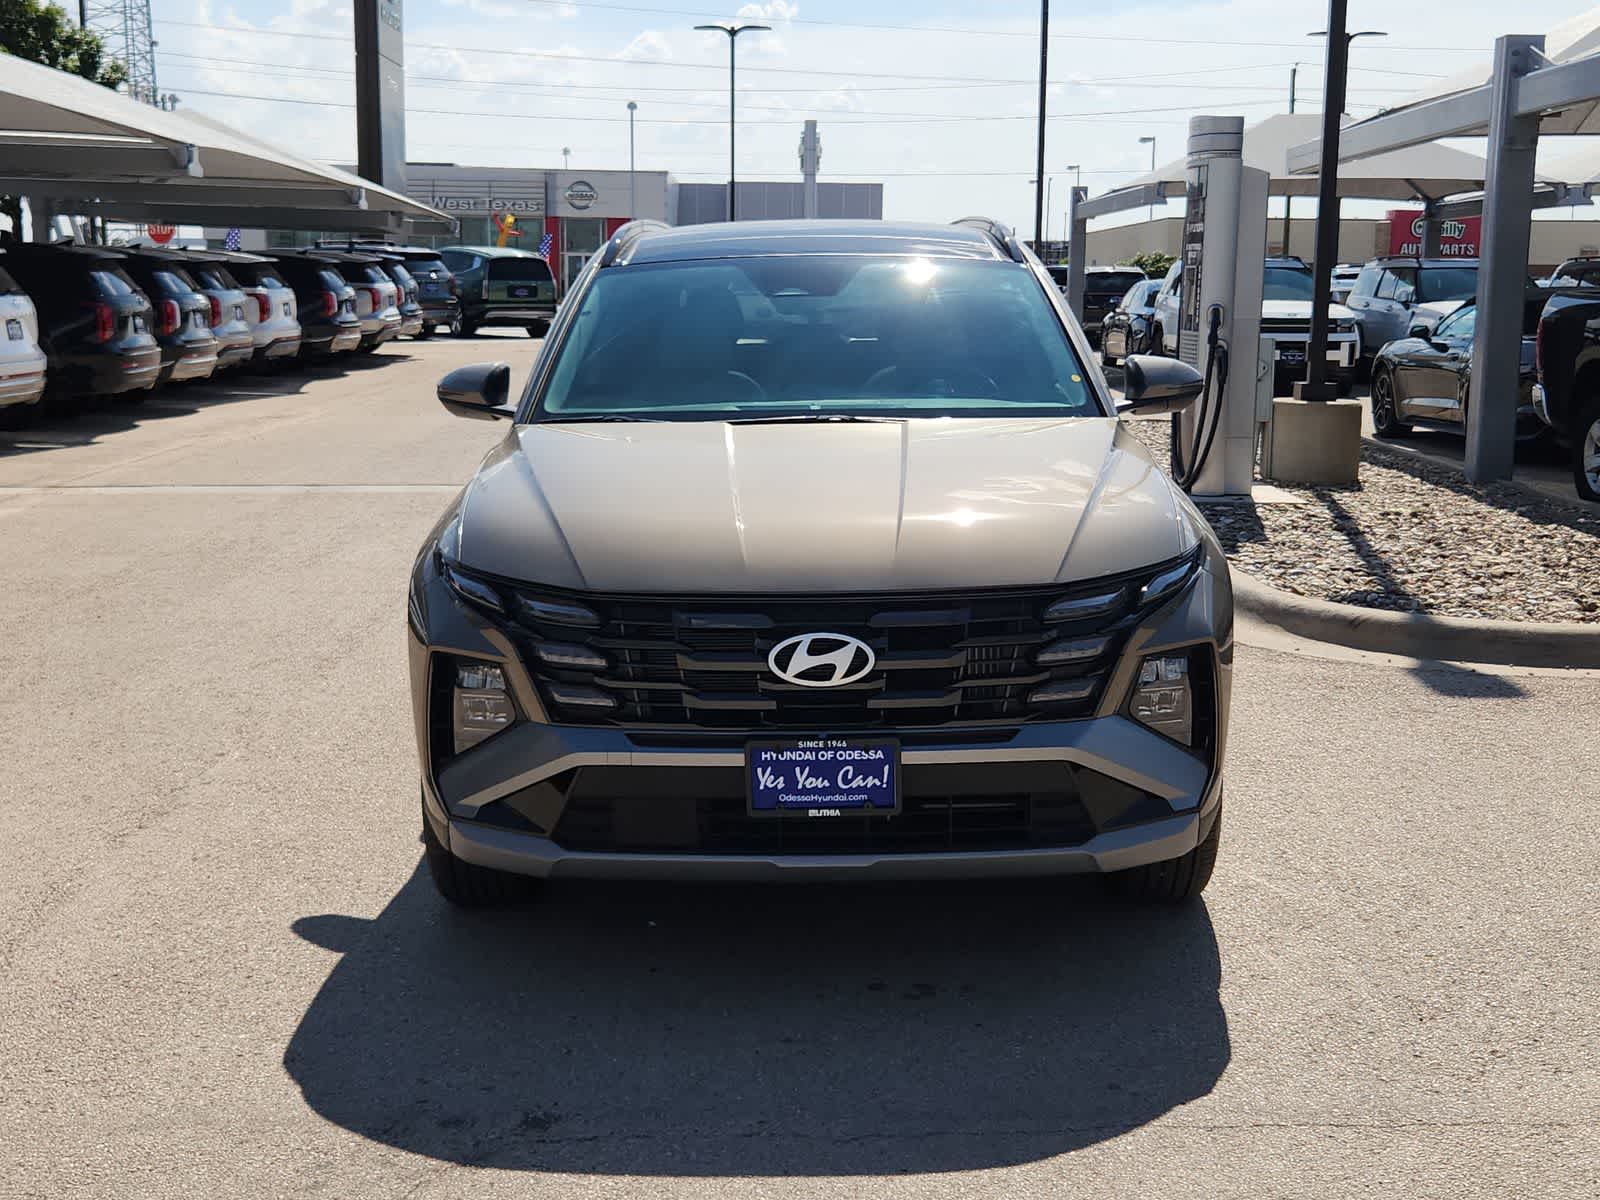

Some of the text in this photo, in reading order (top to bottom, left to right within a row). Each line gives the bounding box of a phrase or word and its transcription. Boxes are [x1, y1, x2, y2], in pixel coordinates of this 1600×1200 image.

[430, 196, 537, 212] West Texas
[827, 740, 847, 748] 1946
[761, 750, 884, 761] HYUNDAI OF ODESSA
[756, 764, 890, 790] Yes You Can!
[778, 793, 868, 803] OdessaHyundai.com
